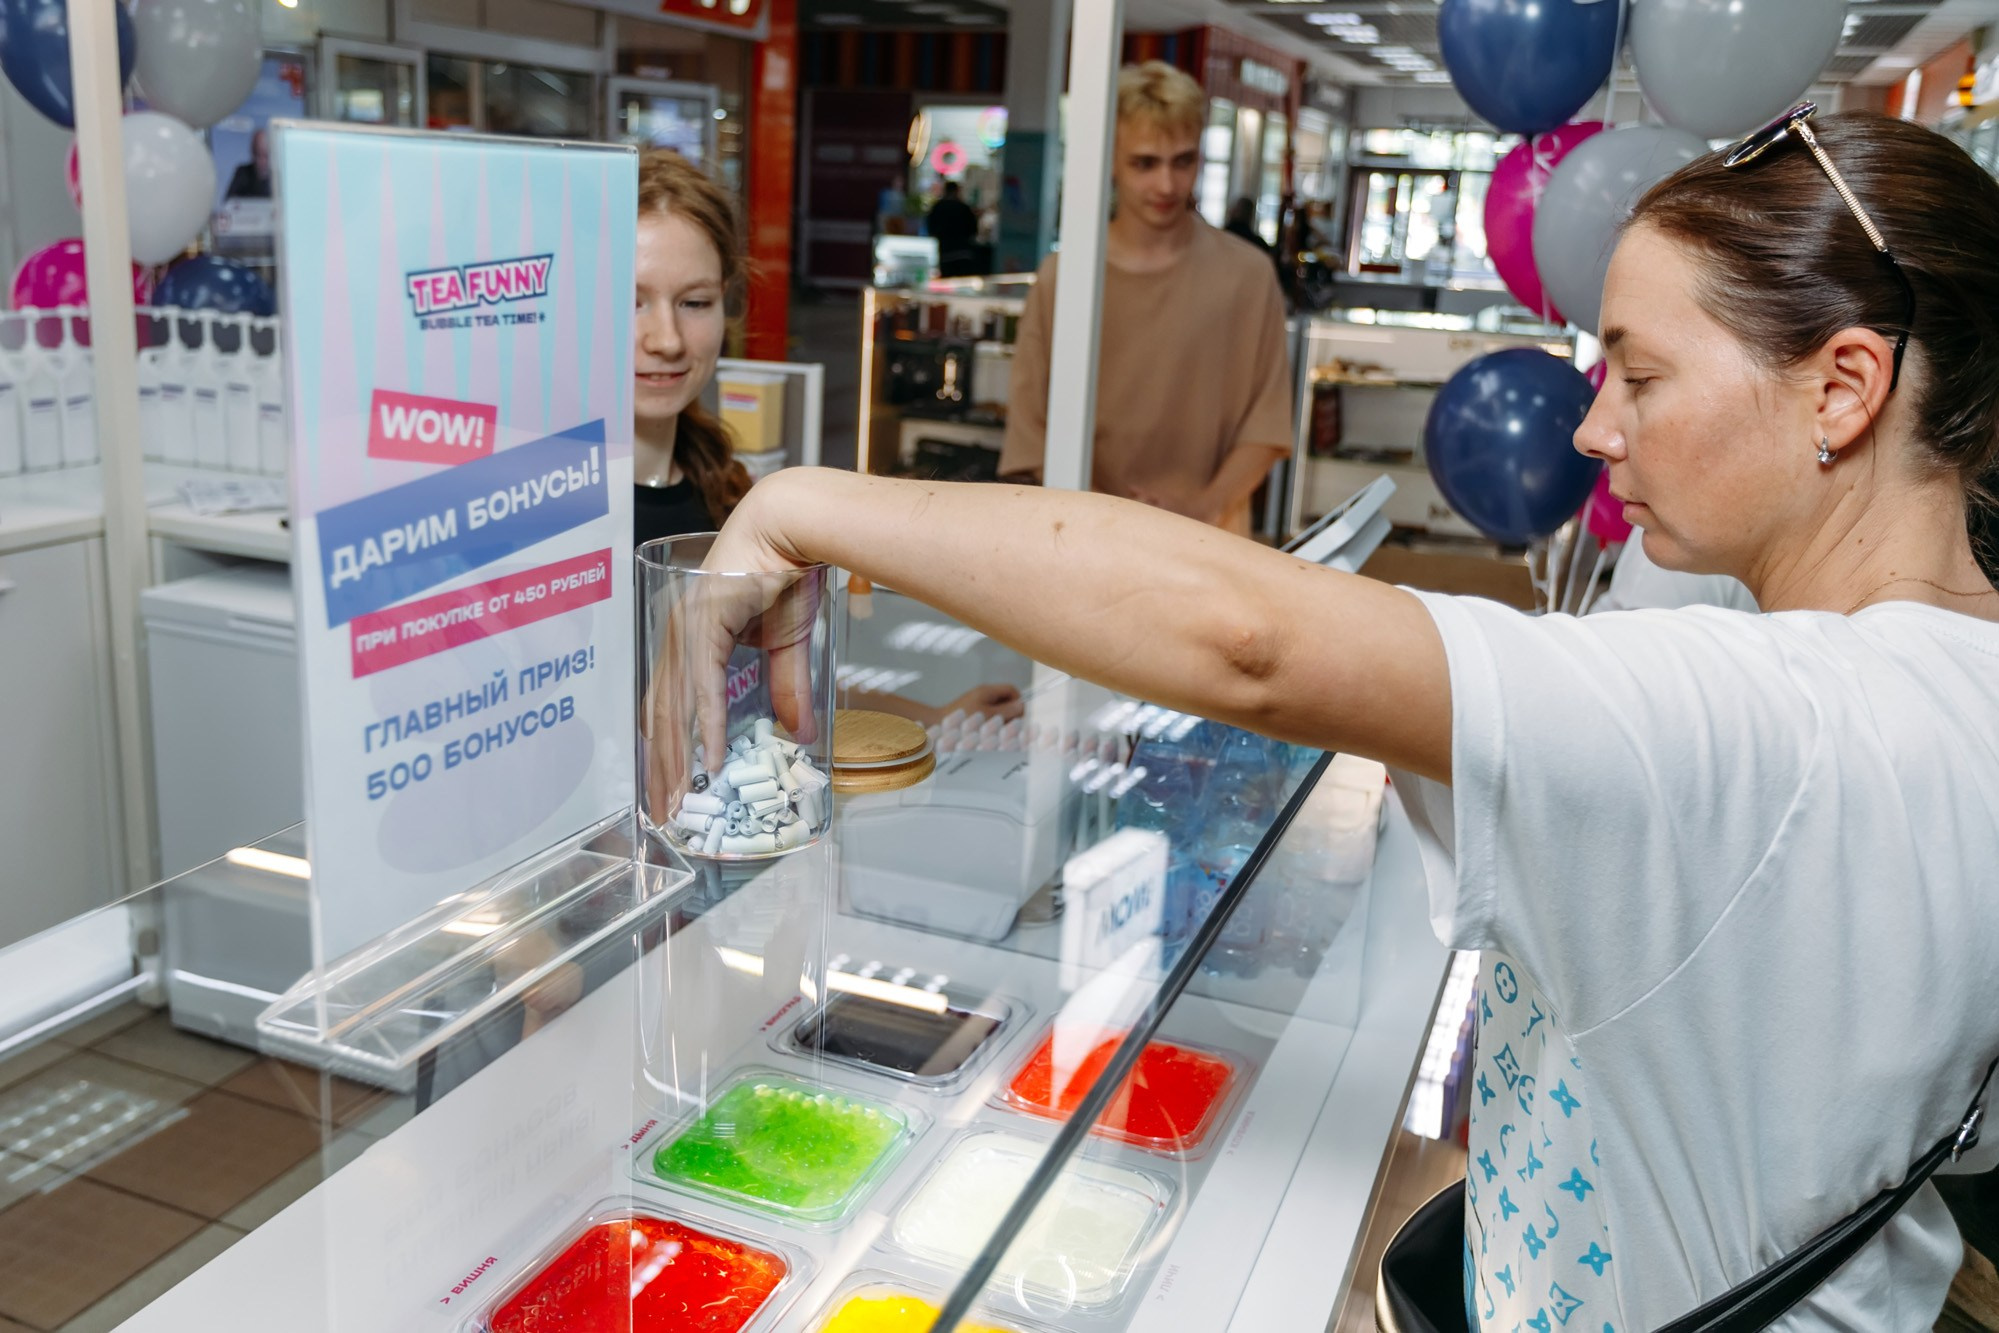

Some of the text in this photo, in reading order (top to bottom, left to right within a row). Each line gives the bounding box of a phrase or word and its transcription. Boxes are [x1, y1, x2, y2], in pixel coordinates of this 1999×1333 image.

[408, 255, 552, 315] TEA FUNNY
[420, 312, 537, 330] BUBBLE TEA TIME!
[380, 404, 485, 448] WOW!
[331, 446, 600, 588] ДАРИМ БОНУСЫ!
[356, 562, 606, 653] ПРИ ПОКУПКЕ ОТ 450 РУБЛЕЙ
[364, 645, 594, 753] ГЛАВНЫЙ ПРИЗ!
[726, 660, 759, 706] NNY
[367, 696, 575, 800] 500 БОНУСОВ
[451, 1256, 498, 1295] ВИШНЯ
